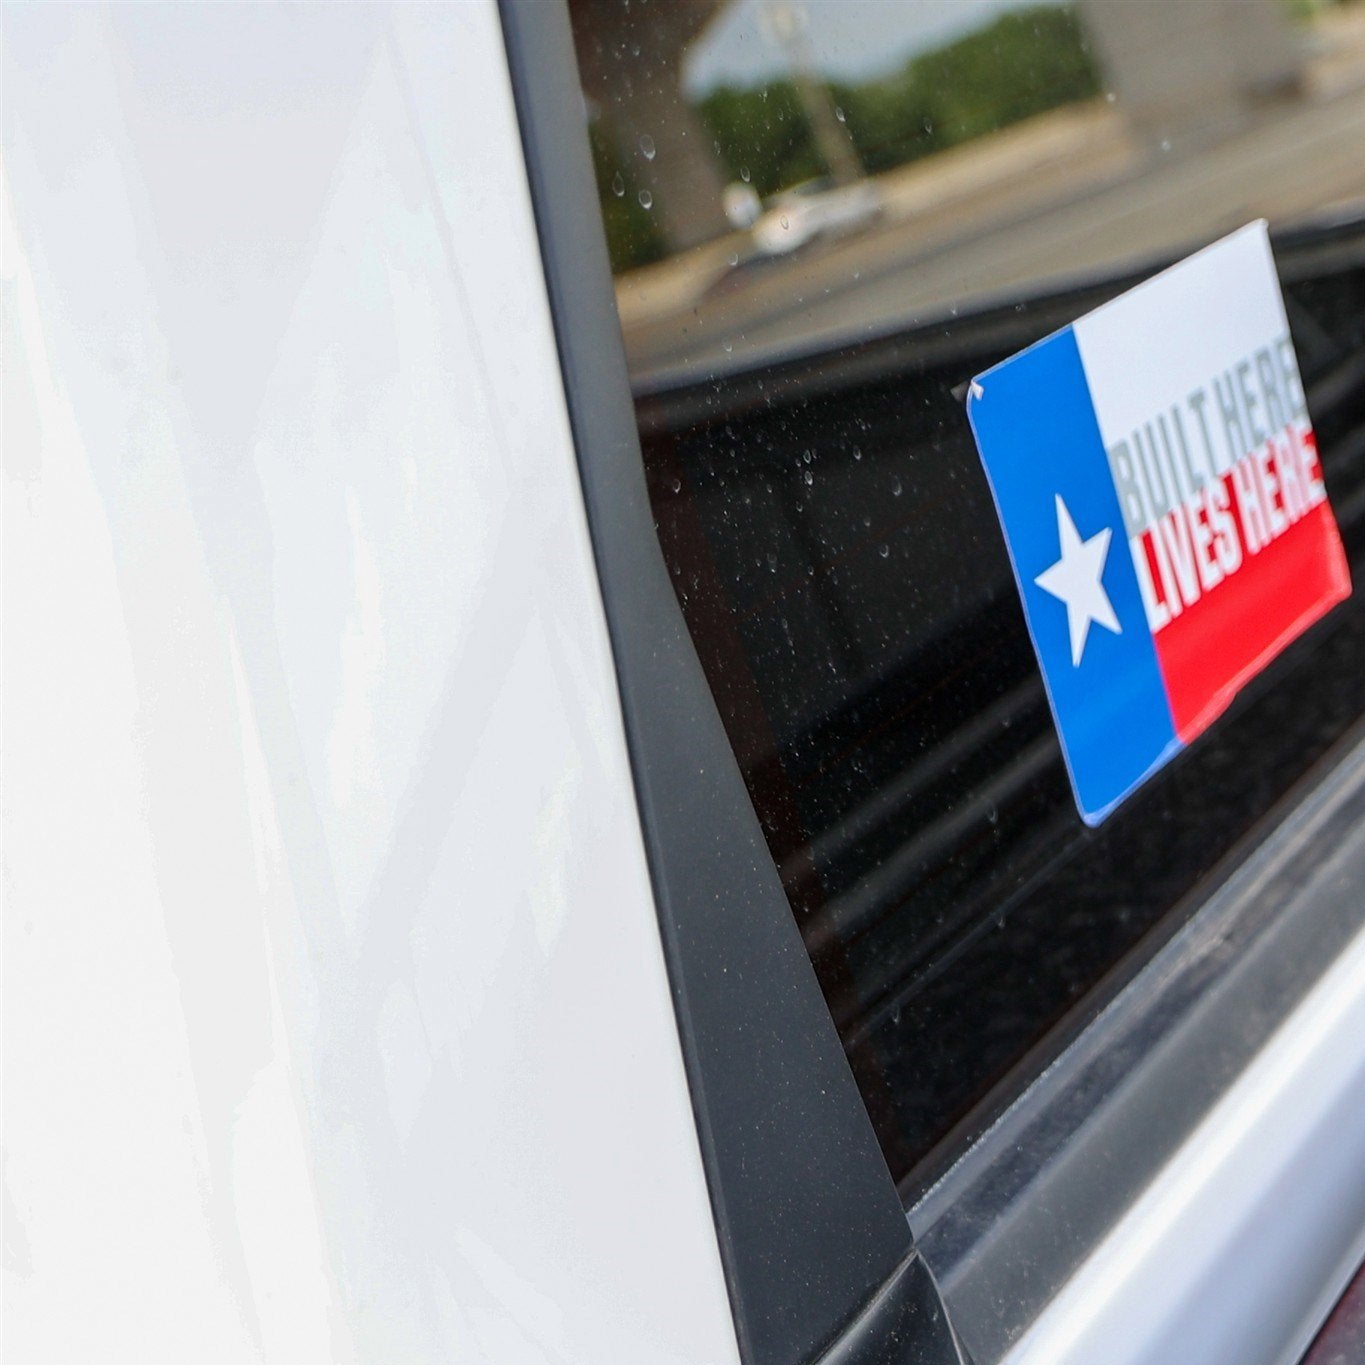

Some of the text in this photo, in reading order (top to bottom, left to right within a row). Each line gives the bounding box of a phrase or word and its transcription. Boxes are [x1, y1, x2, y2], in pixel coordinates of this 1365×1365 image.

[1107, 334, 1309, 538] BUILT HERE
[1130, 417, 1328, 633] LIVES HERE
